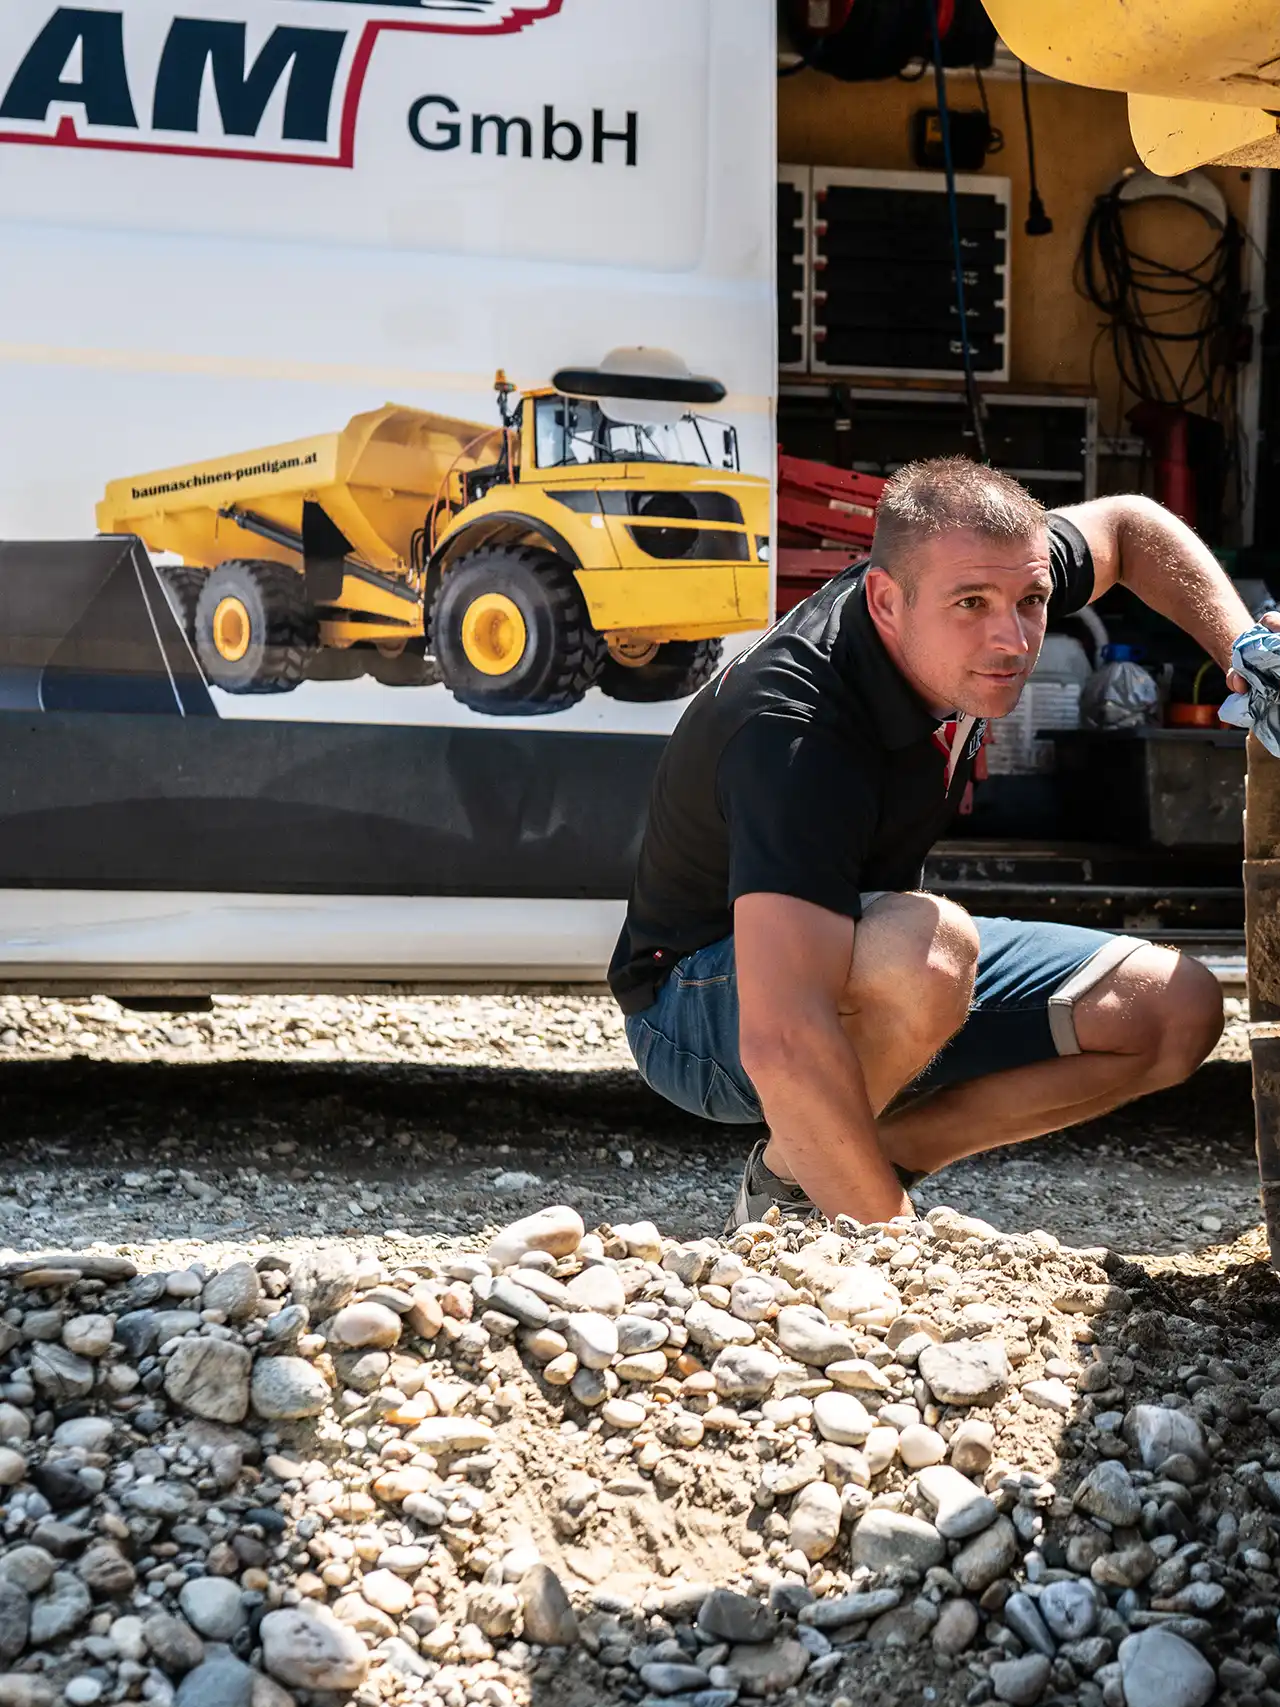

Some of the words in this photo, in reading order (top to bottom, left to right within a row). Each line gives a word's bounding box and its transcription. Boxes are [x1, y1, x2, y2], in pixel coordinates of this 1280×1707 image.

[0, 7, 348, 142] AM
[407, 94, 638, 167] GmbH
[131, 452, 318, 500] baumaschinen-puntigam.at
